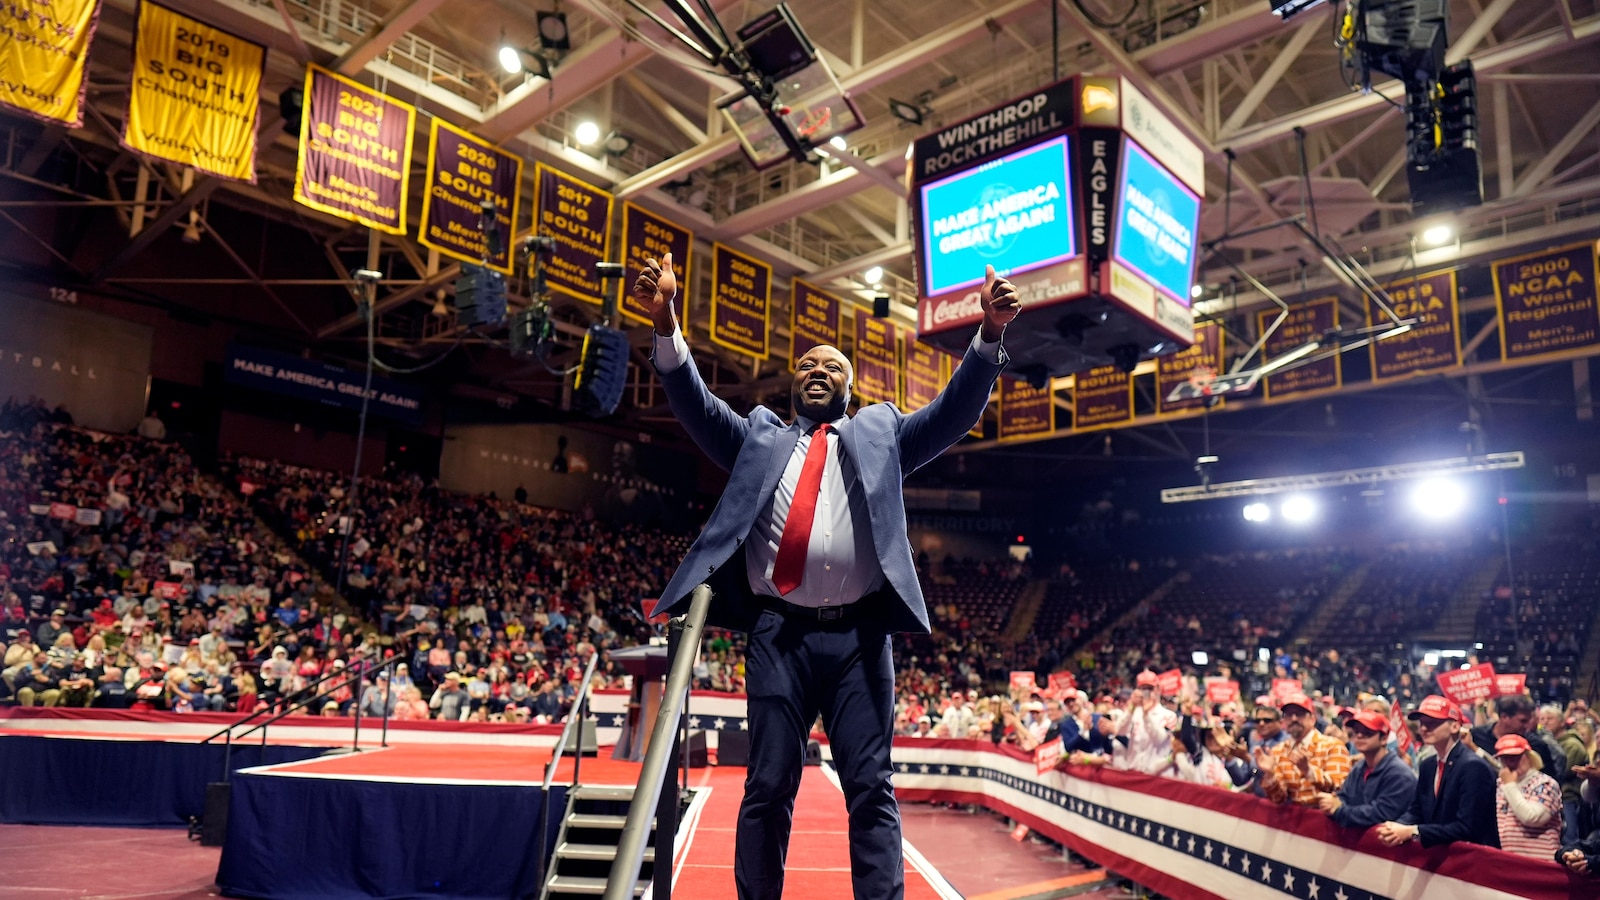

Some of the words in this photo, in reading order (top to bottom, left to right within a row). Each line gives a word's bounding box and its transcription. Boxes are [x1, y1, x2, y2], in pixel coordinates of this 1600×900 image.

[176, 27, 229, 58] 2019
[177, 49, 223, 75] BIG
[149, 60, 245, 103] SOUTH
[138, 77, 249, 122] Champions
[339, 91, 384, 119] 2021
[339, 111, 381, 138] BIG
[938, 94, 1048, 149] WINTHROP
[142, 129, 239, 166] Volleyball
[316, 122, 399, 164] SOUTH
[309, 139, 401, 180] Champions
[456, 143, 497, 170] 2020
[458, 161, 494, 187] BIG
[308, 181, 396, 221] Basketball
[329, 175, 380, 201] Men's
[439, 170, 508, 209] SOUTH
[557, 184, 593, 206] 2017
[1090, 140, 1107, 246] EAGLES
[558, 200, 589, 222] BIG
[934, 206, 980, 237] MAKE
[981, 182, 1060, 220] AMERICA
[538, 223, 604, 258] Champions
[543, 210, 602, 245] SOUTH
[939, 224, 990, 254] GREAT
[995, 204, 1055, 239] AGAIN!
[644, 236, 670, 254] BIG
[552, 255, 587, 277] Men's
[1520, 257, 1570, 279] 2000
[731, 273, 754, 290] BIG
[1046, 280, 1081, 297] CLUB
[1508, 271, 1584, 297] NCAA
[49, 287, 78, 305] 124
[717, 295, 765, 321] Champions
[720, 283, 764, 309] SOUTH
[1523, 289, 1574, 308] West
[1507, 298, 1593, 323] Regional
[797, 314, 836, 339] SOUTH
[1528, 324, 1575, 341] Men's
[1395, 347, 1435, 361] Men's
[1511, 330, 1595, 353] Basketball
[1163, 354, 1215, 373] SOUTH
[1381, 352, 1453, 373] Basketball
[233, 358, 274, 378] MAKE
[276, 367, 336, 391] AMERICA
[338, 381, 378, 402] GREAT
[379, 390, 419, 410] AGAIN!
[1079, 372, 1126, 389] SOUTH
[910, 515, 1016, 531] TERRITORY
[1449, 669, 1482, 685] NIKKI
[1455, 686, 1491, 701] TAXES
